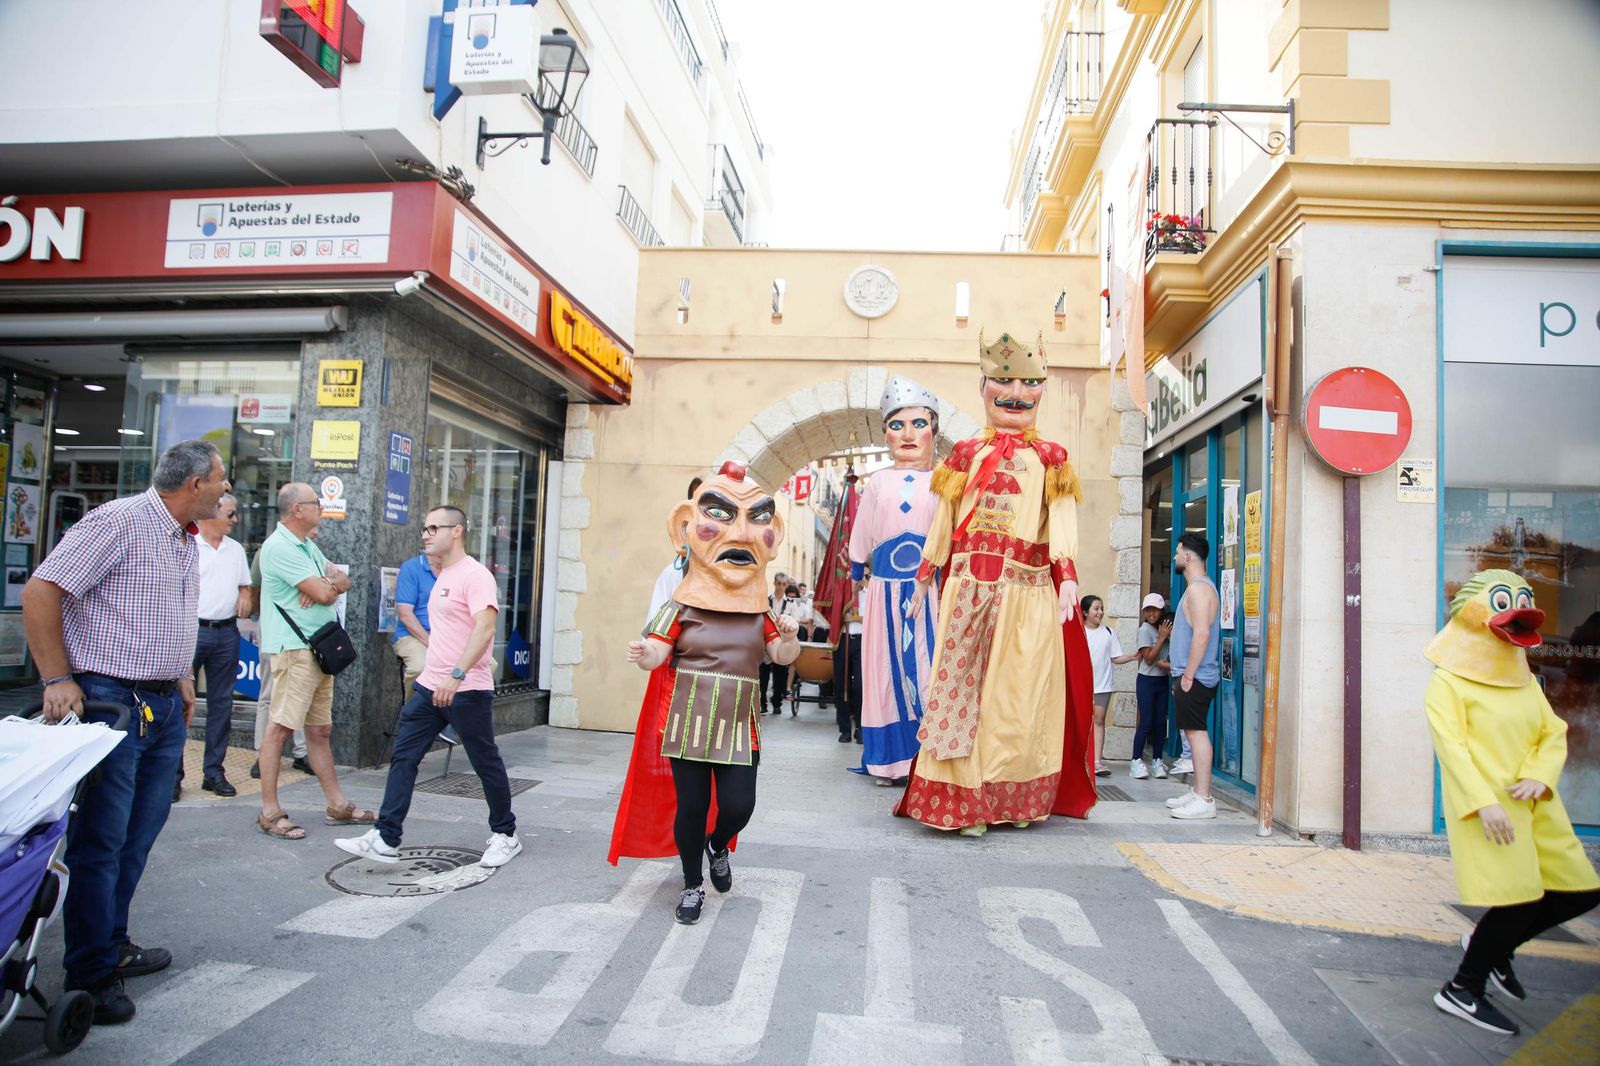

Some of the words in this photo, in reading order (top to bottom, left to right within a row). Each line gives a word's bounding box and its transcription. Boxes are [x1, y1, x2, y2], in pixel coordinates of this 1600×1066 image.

[229, 200, 281, 213] Loterías
[285, 202, 293, 214] y
[229, 215, 288, 229] Apuestas
[291, 213, 311, 225] del
[315, 212, 360, 225] Estado
[0, 195, 85, 262] ÓN
[480, 251, 504, 277] Apuestas
[505, 271, 513, 284] del
[513, 277, 529, 297] Estado
[1540, 302, 1600, 347] p
[314, 461, 336, 469] Punto
[514, 650, 530, 665] DIGI
[413, 861, 1168, 1066] STOP
